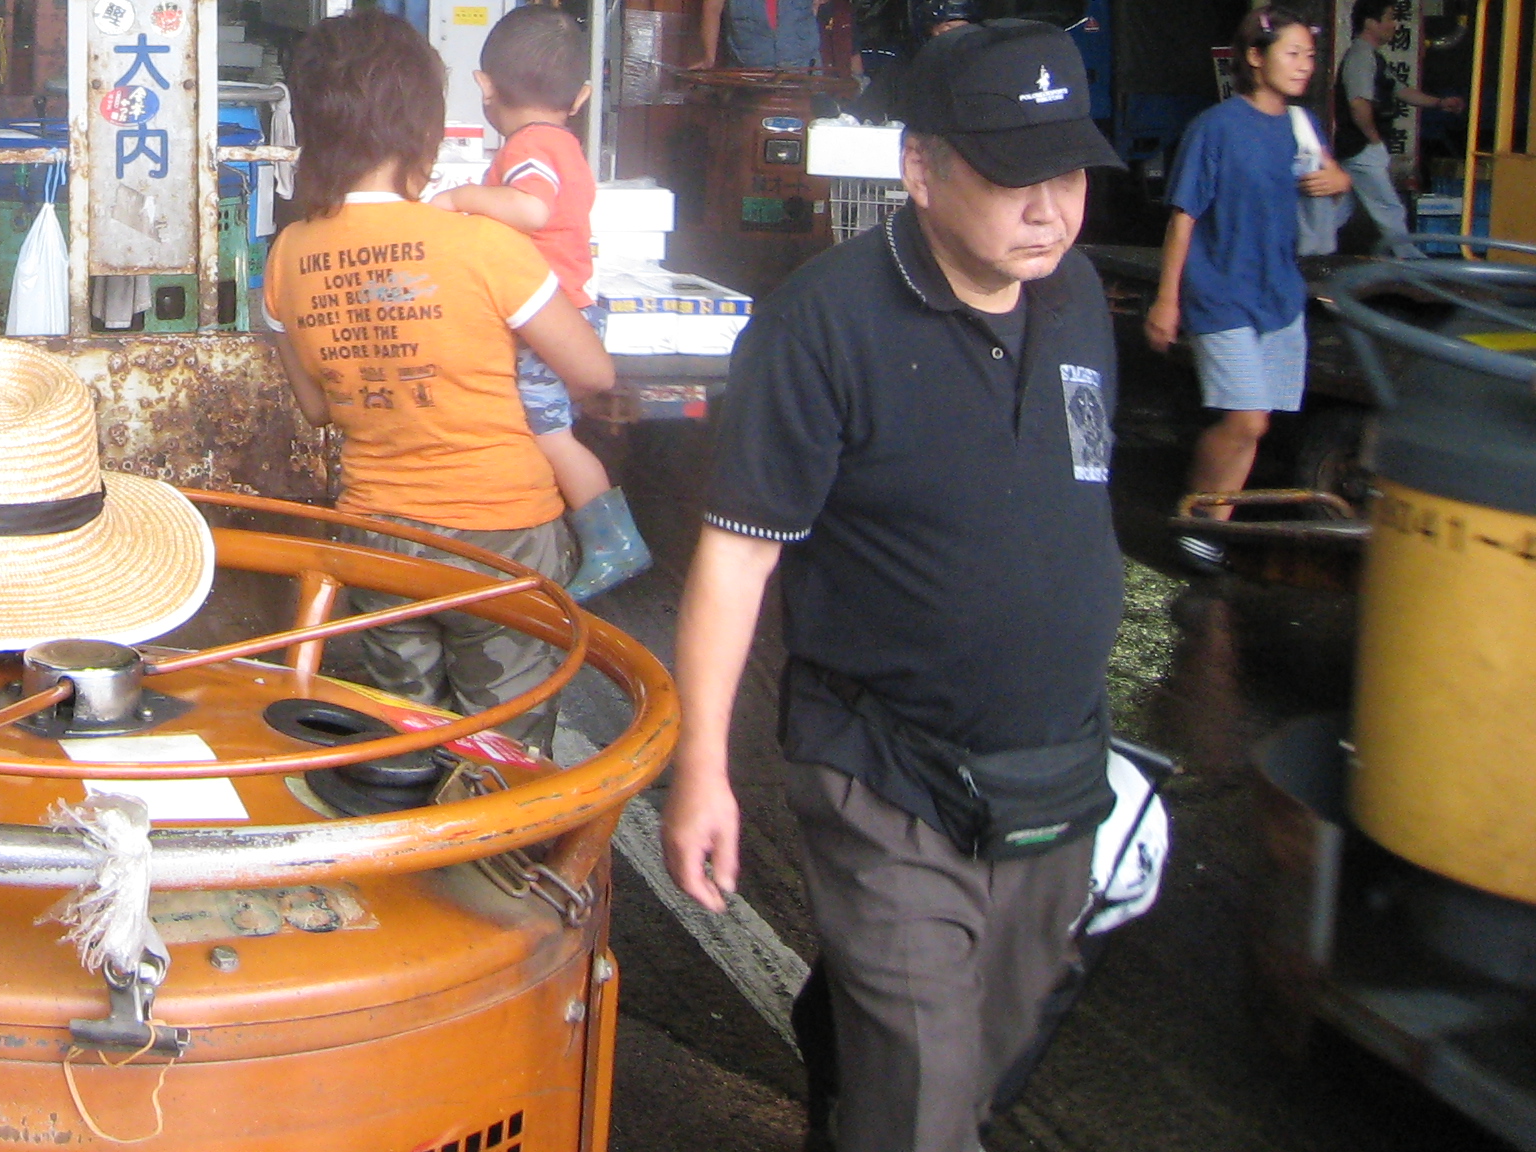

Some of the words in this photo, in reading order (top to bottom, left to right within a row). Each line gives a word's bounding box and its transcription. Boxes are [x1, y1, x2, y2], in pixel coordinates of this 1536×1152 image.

[299, 252, 331, 275] LIKE
[339, 241, 426, 270] FLOWERS
[324, 272, 362, 290] LOVE
[366, 268, 394, 285] THE
[311, 293, 339, 310] SUN
[297, 311, 340, 329] MORE!
[347, 307, 371, 323] THE
[376, 304, 443, 322] OCEANS
[332, 326, 369, 342] LOVE
[373, 325, 399, 339] THE
[319, 344, 370, 361] SHORE
[373, 343, 419, 359] PARTY
